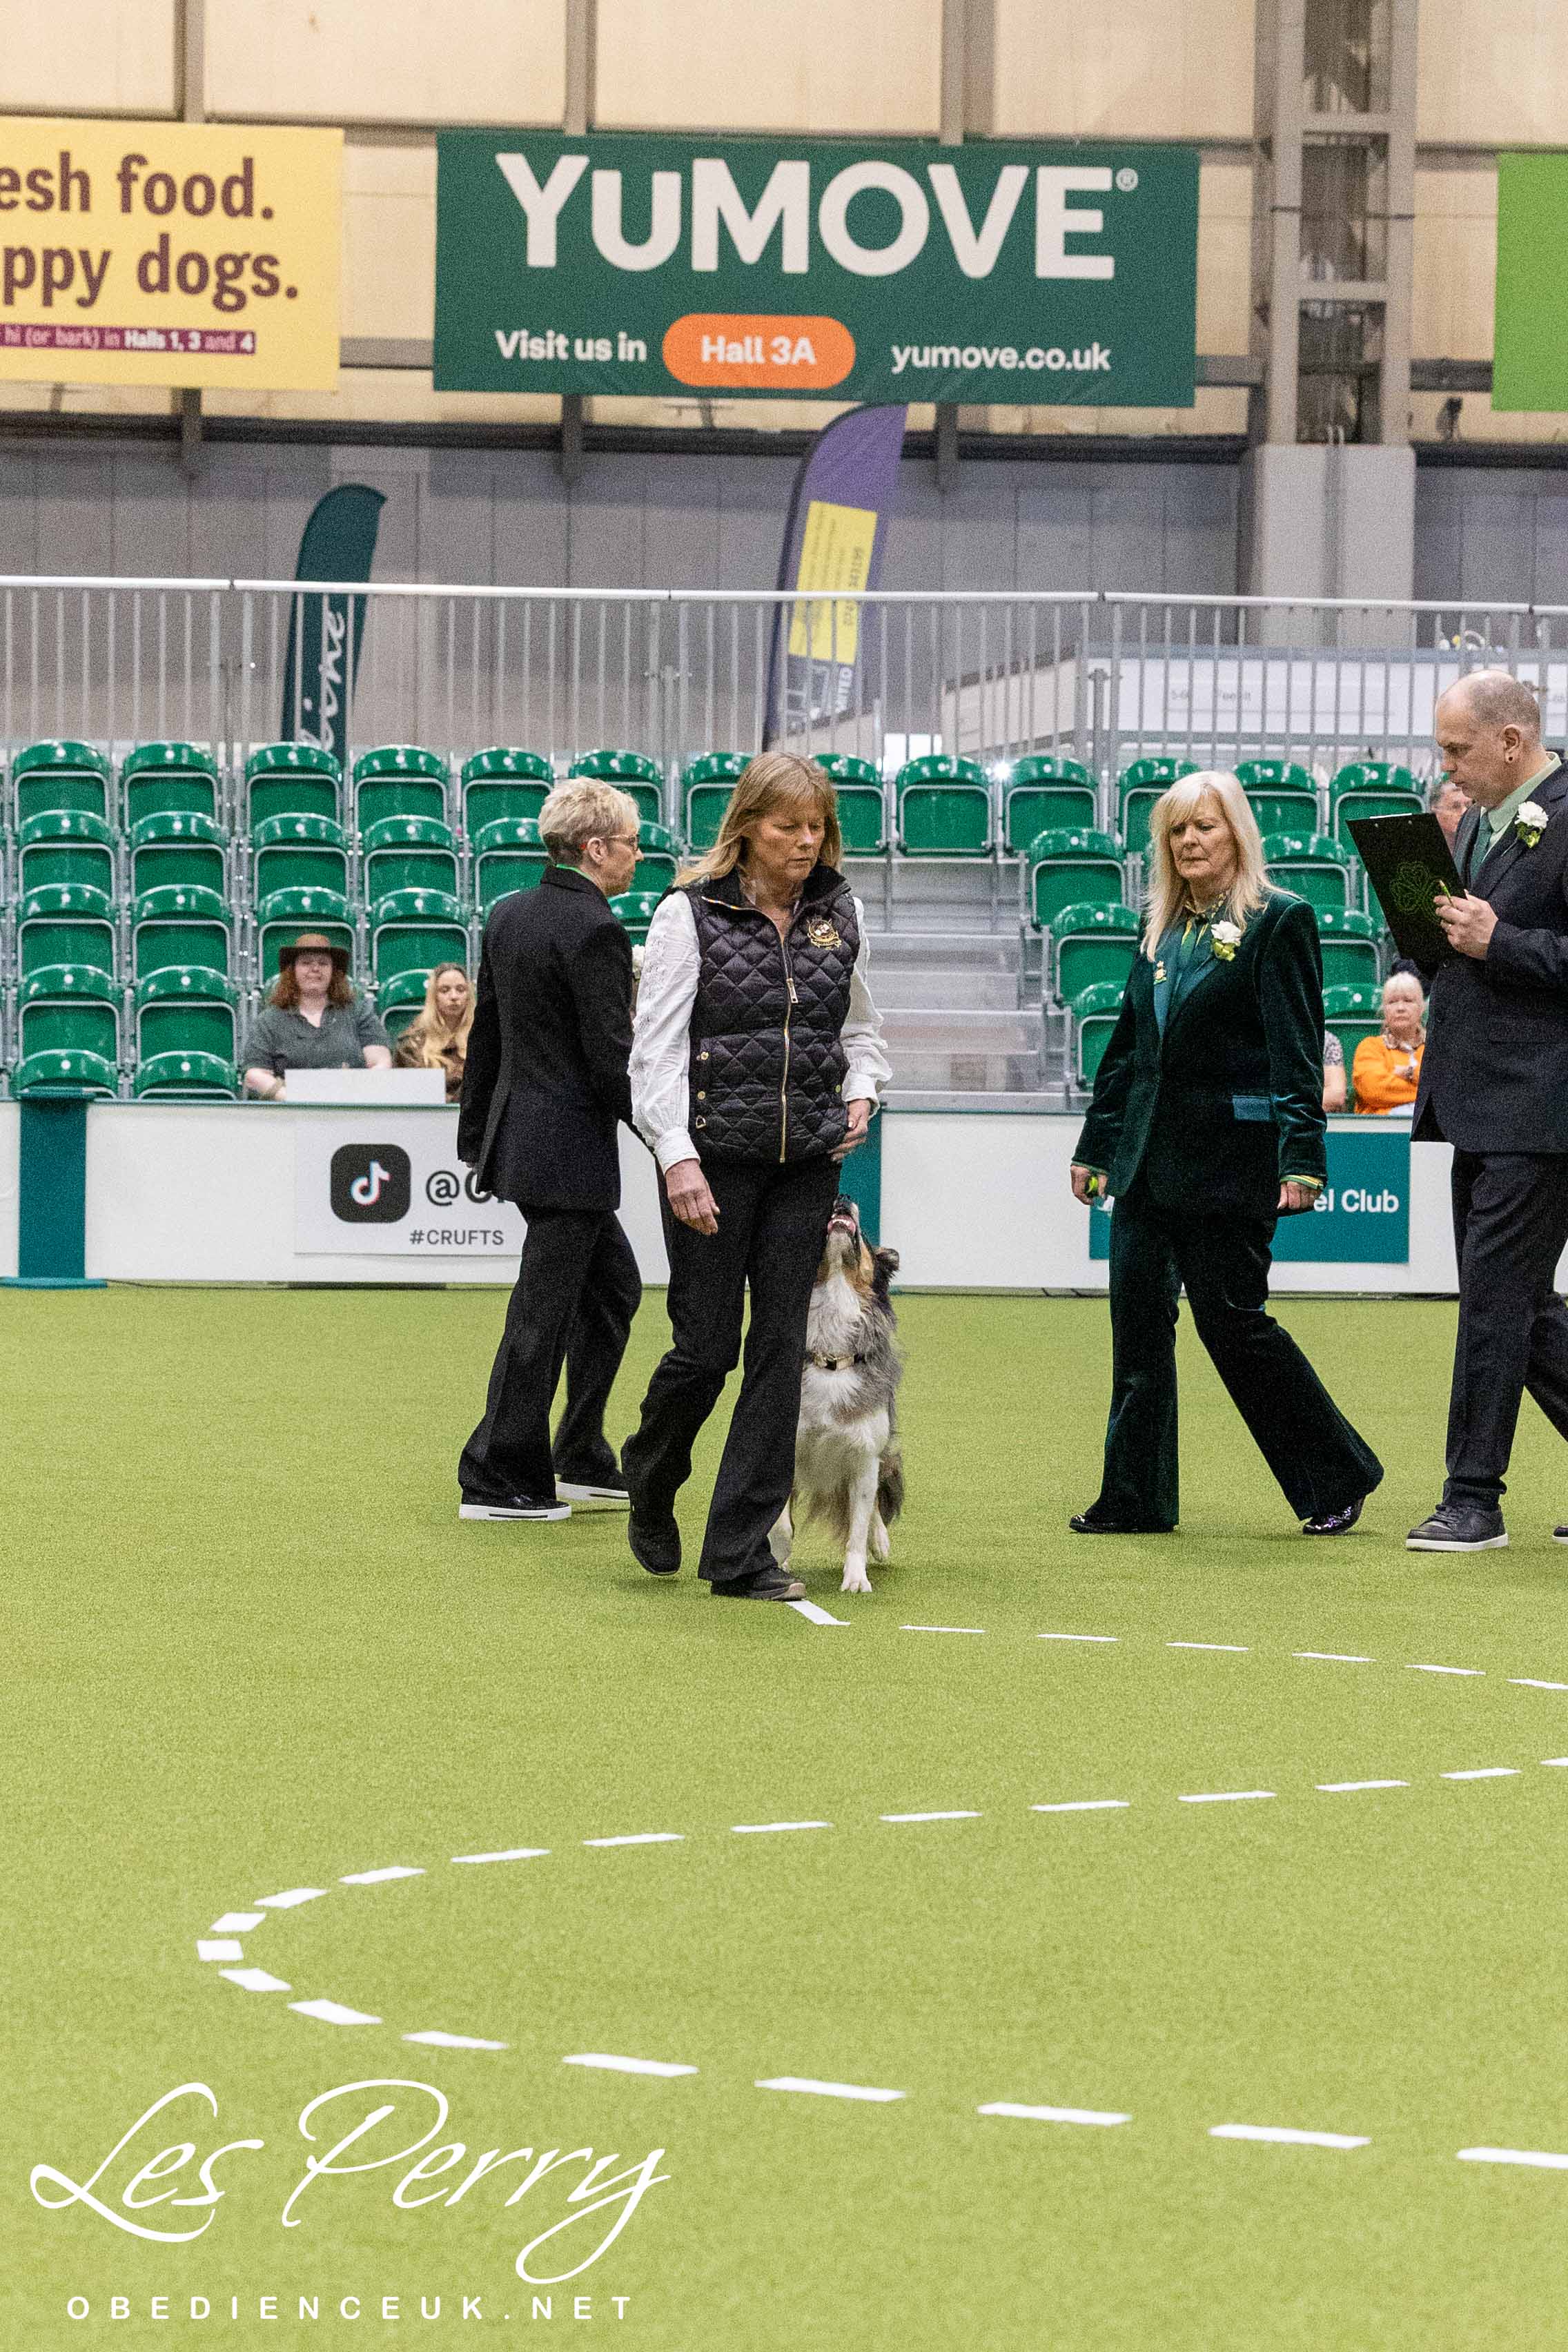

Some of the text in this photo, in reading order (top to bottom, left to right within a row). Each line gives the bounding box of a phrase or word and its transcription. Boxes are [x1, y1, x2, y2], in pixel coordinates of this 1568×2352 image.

[0, 151, 274, 219] esh food.
[3, 233, 298, 313] ppy dogs.
[124, 329, 166, 349] Halls
[171, 331, 184, 351] 1,
[188, 332, 201, 350] 3
[242, 334, 253, 351] 4
[495, 329, 647, 361] Visit us in
[701, 335, 816, 365] Hall 3A
[891, 342, 1111, 373] yumove.co.uk
[426, 1170, 504, 1207] @C
[1341, 1188, 1400, 1213] Club
[410, 1229, 504, 1246] #CRUFTS
